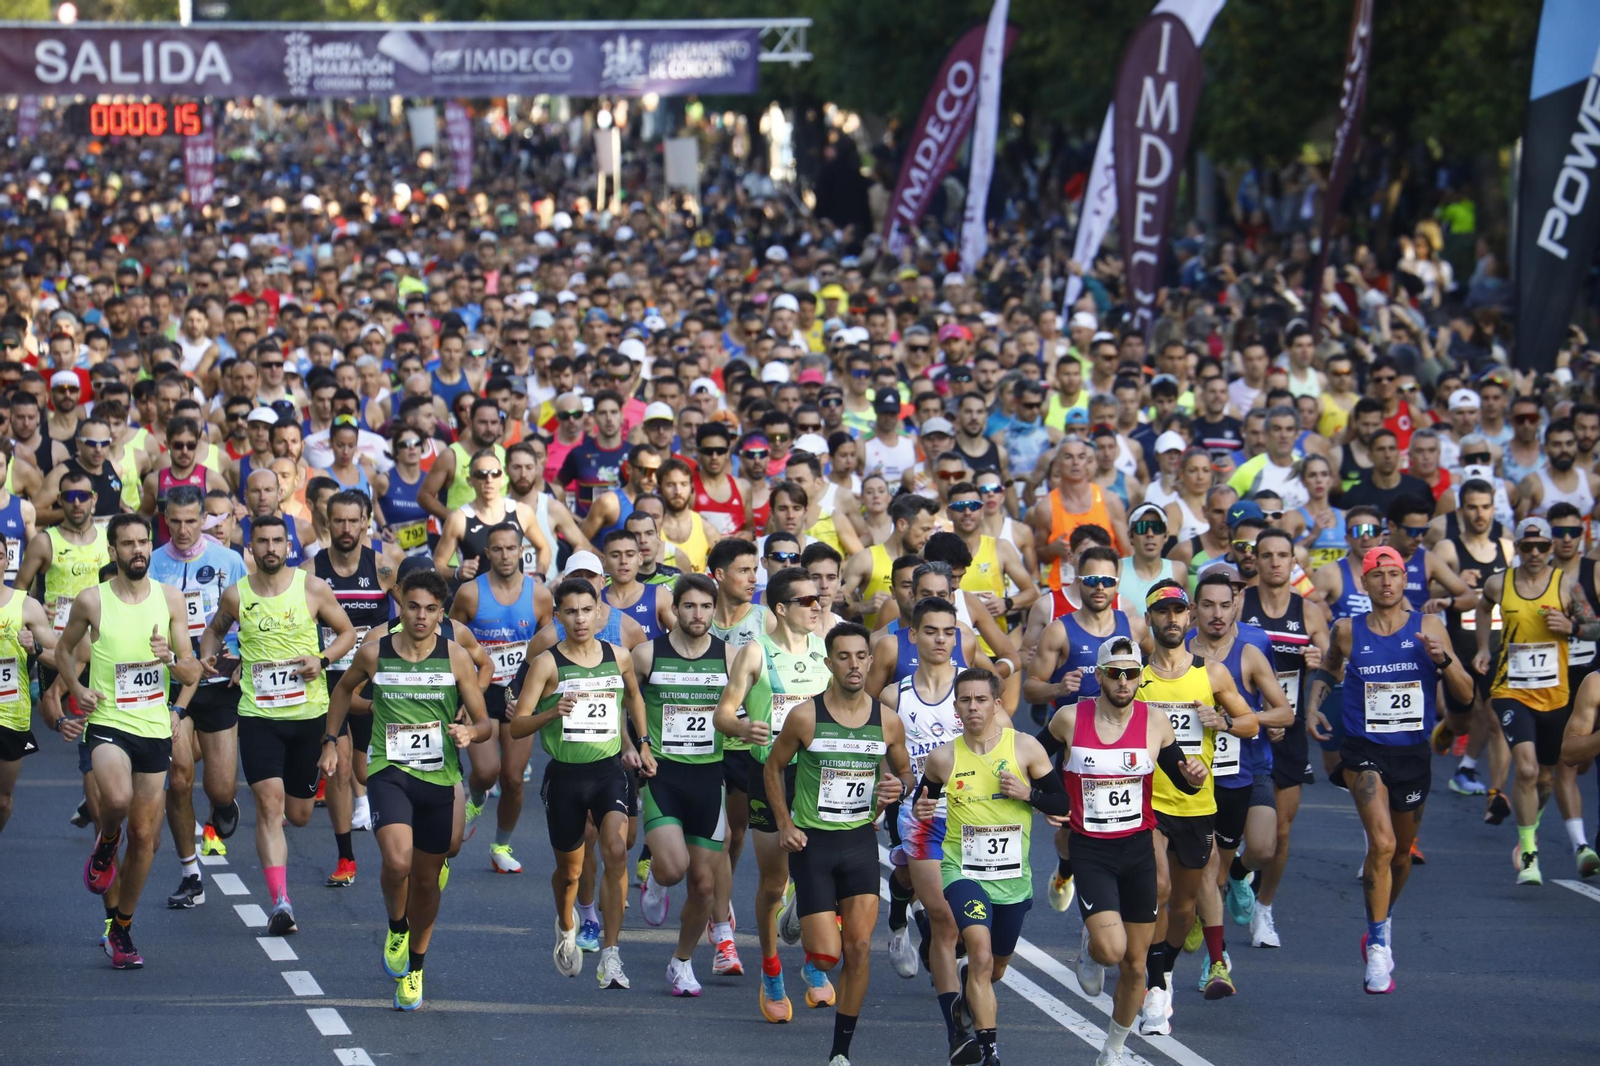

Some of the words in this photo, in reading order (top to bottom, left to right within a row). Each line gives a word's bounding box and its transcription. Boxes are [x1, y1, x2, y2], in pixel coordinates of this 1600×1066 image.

[312, 42, 364, 60] MEDIA
[650, 39, 750, 61] AYUNTAMIENTO
[35, 39, 232, 84] SALIDA
[463, 46, 574, 73] IMDECO
[649, 59, 667, 79] DE
[897, 59, 976, 222] IMDECO
[498, 651, 523, 668] 162
[1529, 653, 1547, 667] 17
[1358, 662, 1419, 675] TROTASIERRA
[133, 669, 160, 687] 403
[269, 669, 299, 686] 174
[381, 691, 412, 700] ATLETISMO
[660, 691, 689, 700] ATLETISMO
[1390, 693, 1412, 709] 28
[587, 703, 607, 718] 23
[686, 716, 707, 731] 22
[411, 733, 430, 749] 21
[820, 760, 850, 768] ATLETISMO
[823, 769, 836, 781] 38
[846, 782, 866, 798] 76
[1083, 781, 1096, 790] 38
[1108, 789, 1131, 807] 64
[963, 825, 975, 837] 38
[987, 837, 1009, 855] 37
